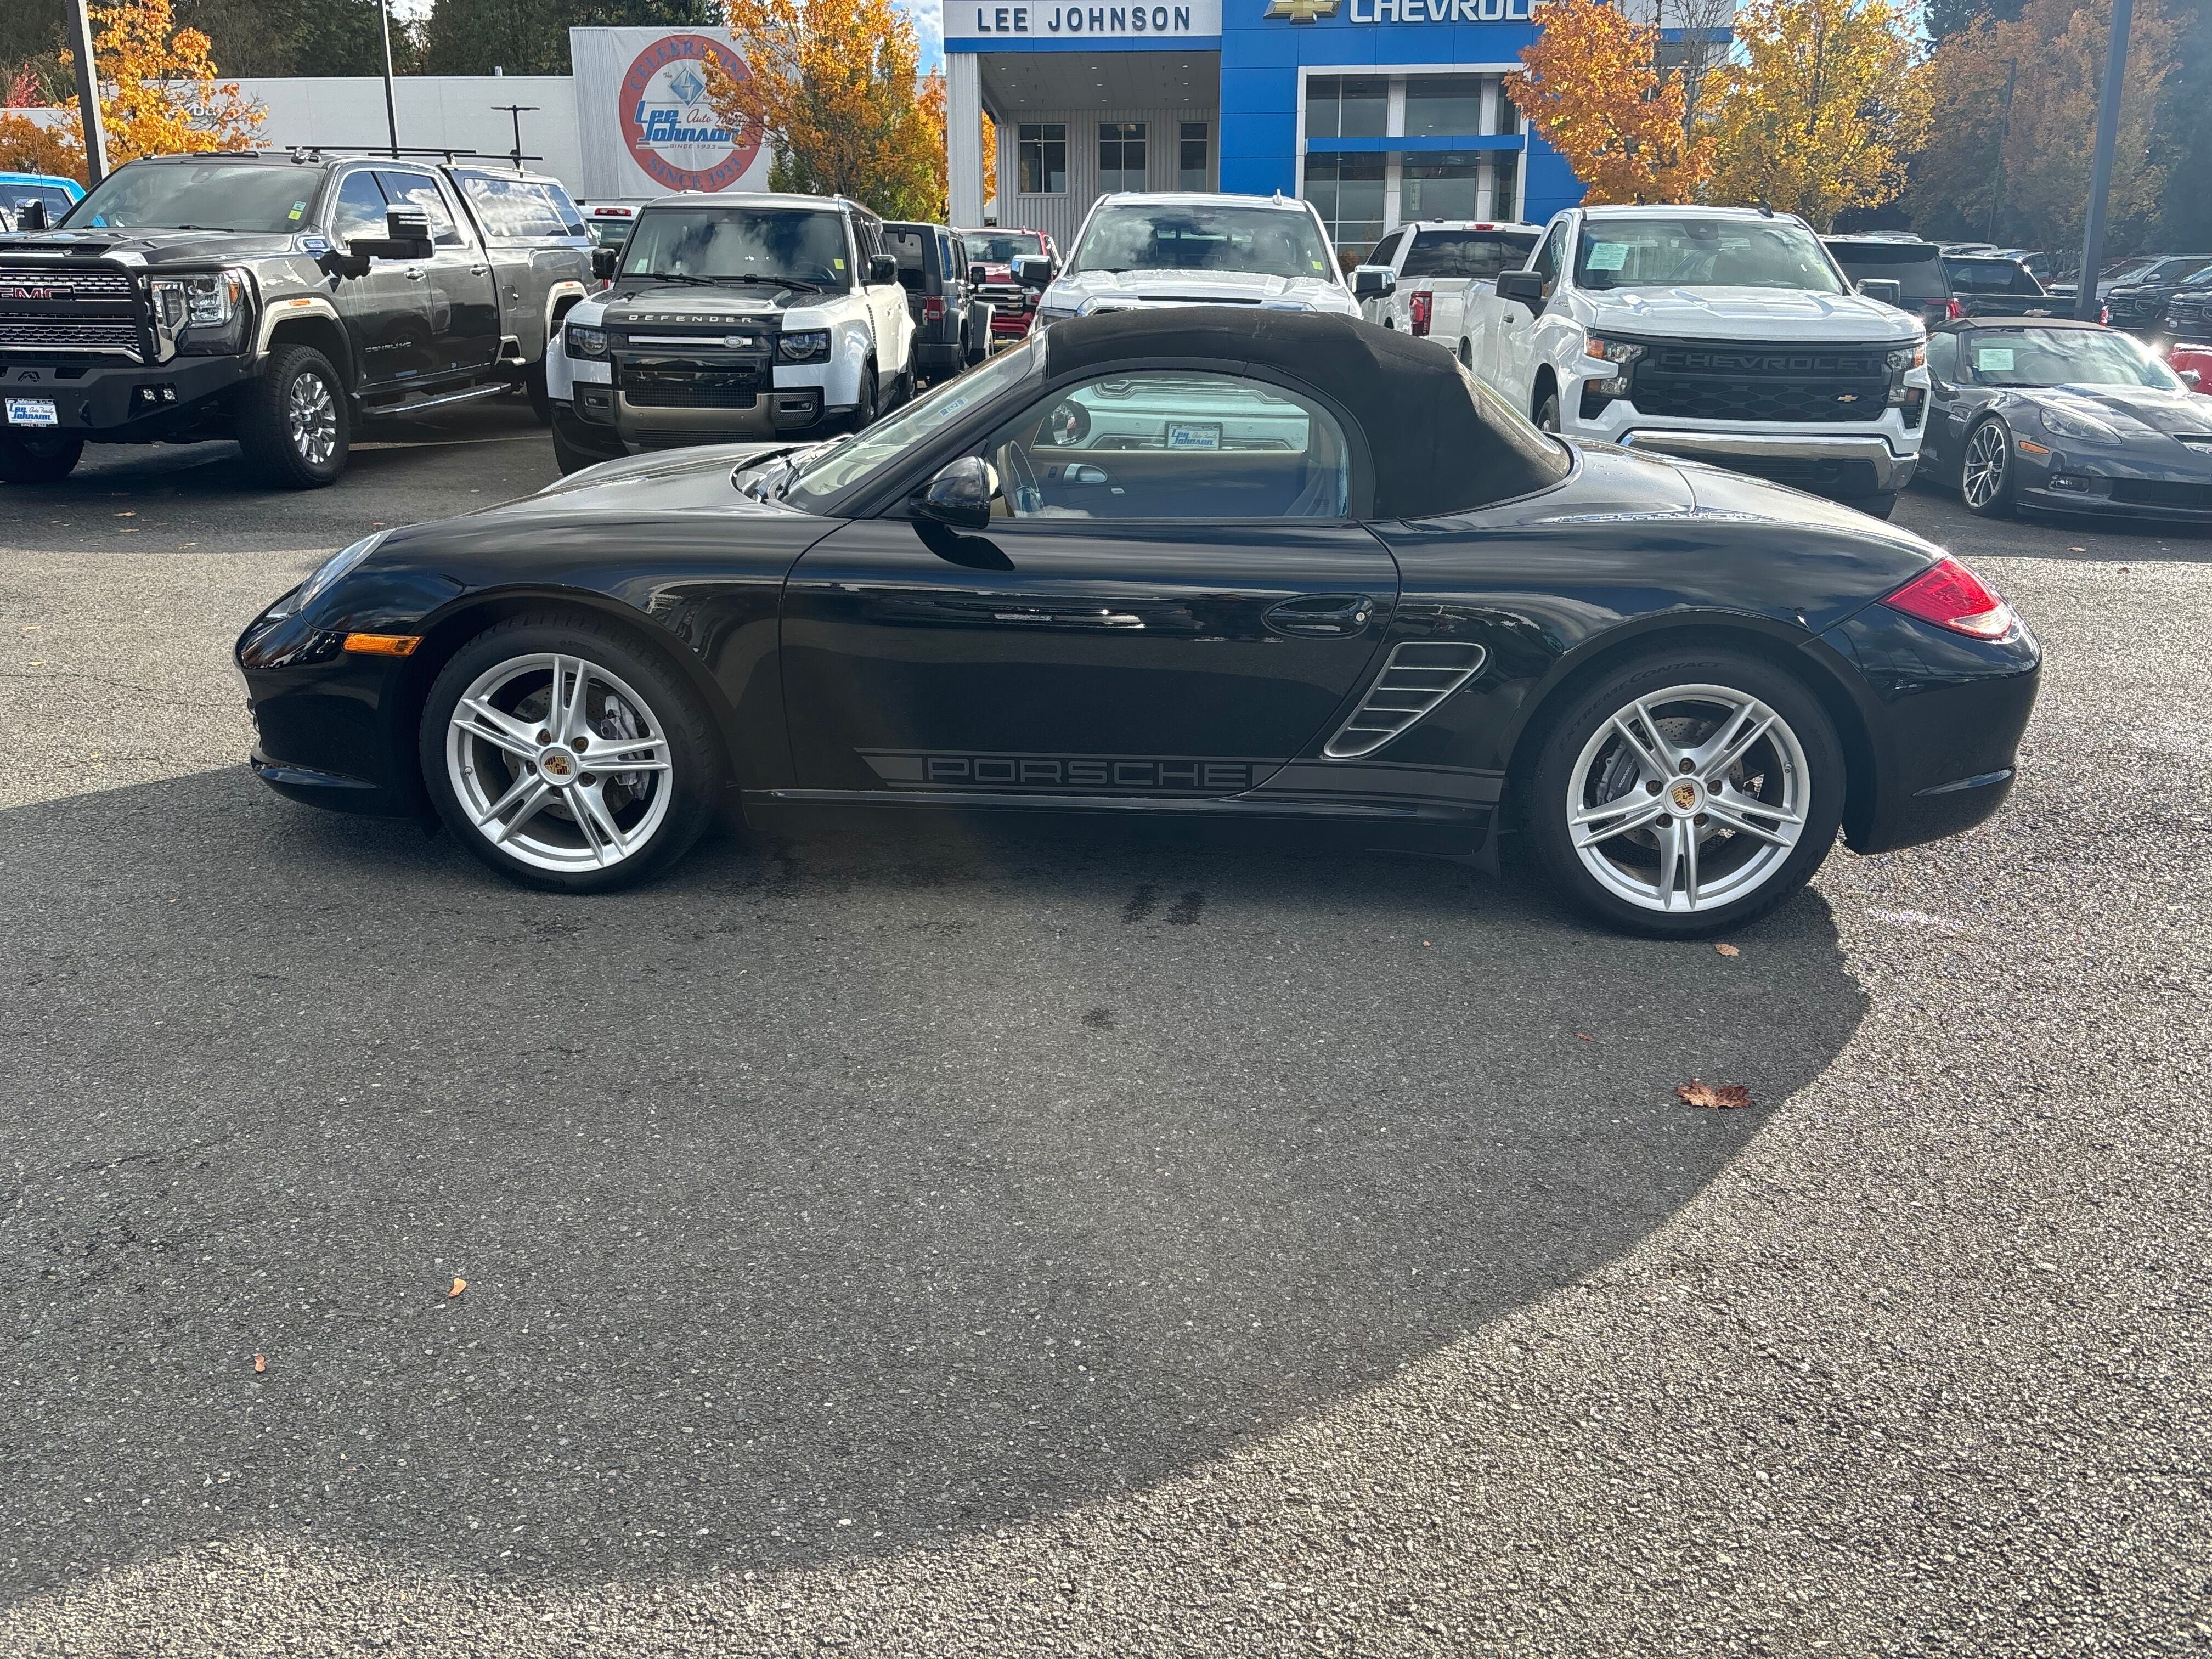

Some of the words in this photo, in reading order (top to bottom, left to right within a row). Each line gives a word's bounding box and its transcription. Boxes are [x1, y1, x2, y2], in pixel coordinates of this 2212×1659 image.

[978, 8, 1028, 31] LEE
[1048, 6, 1190, 31] JOHNSON
[1350, 0, 1558, 22] CHEVROL
[635, 101, 681, 123] Lee
[686, 108, 713, 123] Auto
[638, 118, 740, 142] Johnson
[647, 157, 703, 189] SINCE
[709, 157, 742, 187] 1933
[629, 315, 752, 323] DEFENDER
[1661, 353, 1880, 370] CHEVROLET
[9, 403, 27, 412] Lee
[11, 410, 52, 420] Johnson
[1171, 429, 1190, 438] Lee
[1172, 436, 1214, 445] Johnson
[928, 758, 1247, 787] PORSCHE
[1618, 759, 1635, 788] PORSCH
